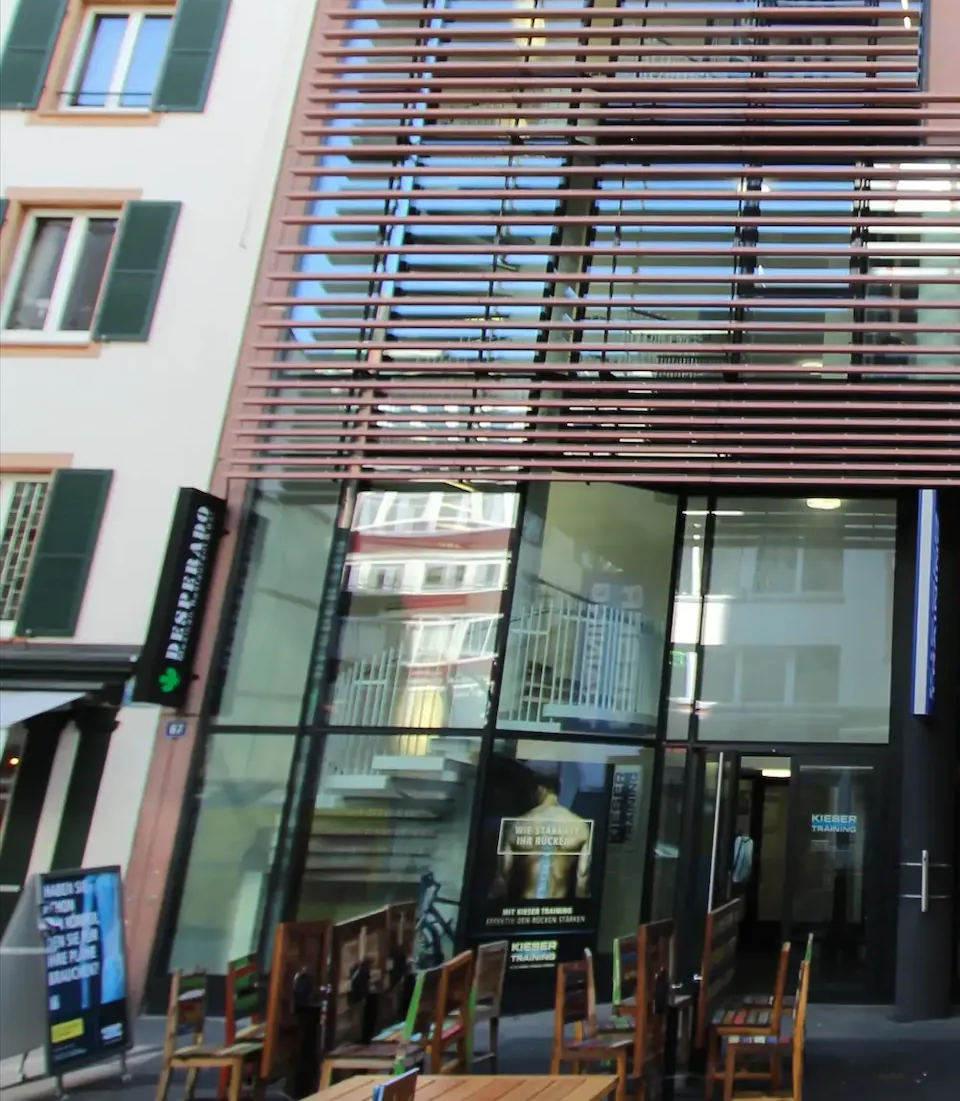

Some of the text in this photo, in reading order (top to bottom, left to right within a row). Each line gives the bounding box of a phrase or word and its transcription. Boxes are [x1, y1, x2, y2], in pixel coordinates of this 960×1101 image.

[165, 505, 209, 661] DESPERADO
[811, 814, 857, 823] KIESER
[811, 825, 857, 833] TRAINING
[517, 907, 540, 915] KIESER
[541, 906, 573, 915] TRAINING
[511, 940, 558, 952] KIESER
[510, 952, 557, 963] TRAINING
